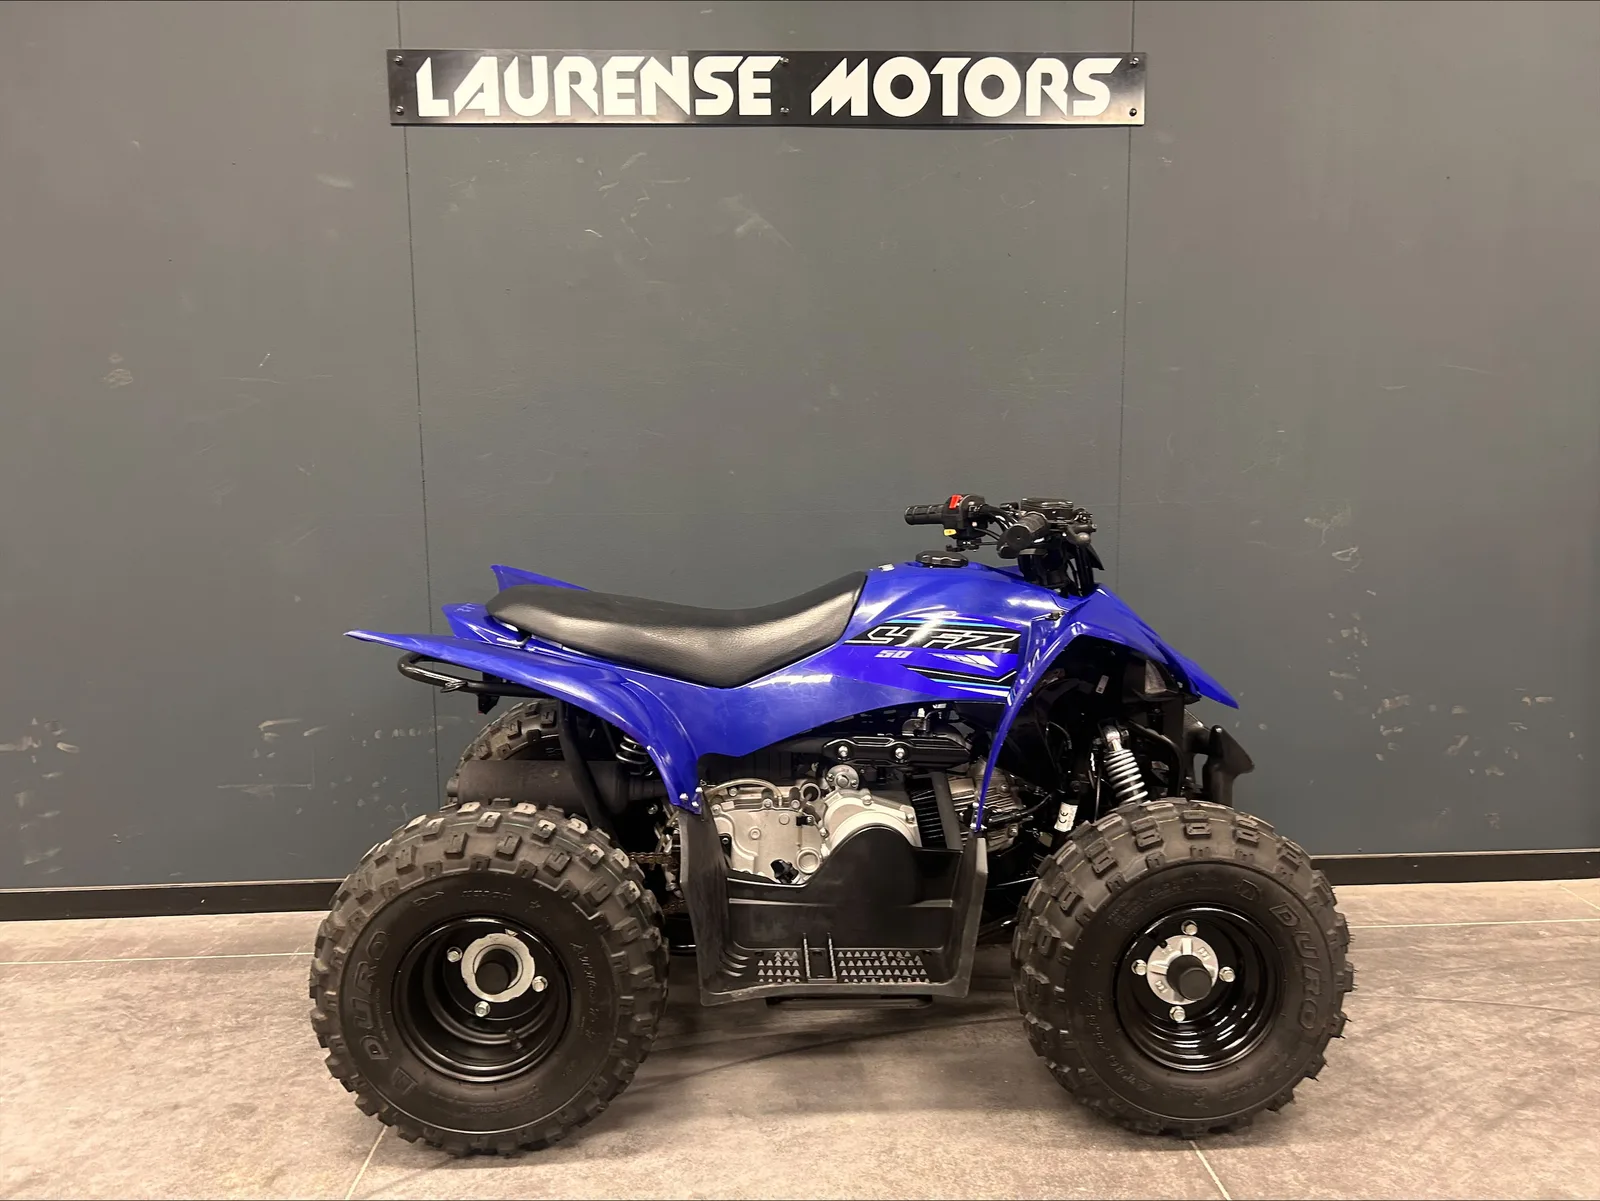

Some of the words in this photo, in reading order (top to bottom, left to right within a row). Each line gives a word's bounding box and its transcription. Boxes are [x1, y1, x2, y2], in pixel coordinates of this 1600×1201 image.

[415, 55, 783, 117] LAURENSE
[810, 56, 1123, 117] MOTORS
[875, 649, 914, 659] 50
[350, 930, 390, 1060] DURO
[1269, 902, 1321, 1030] DURO
